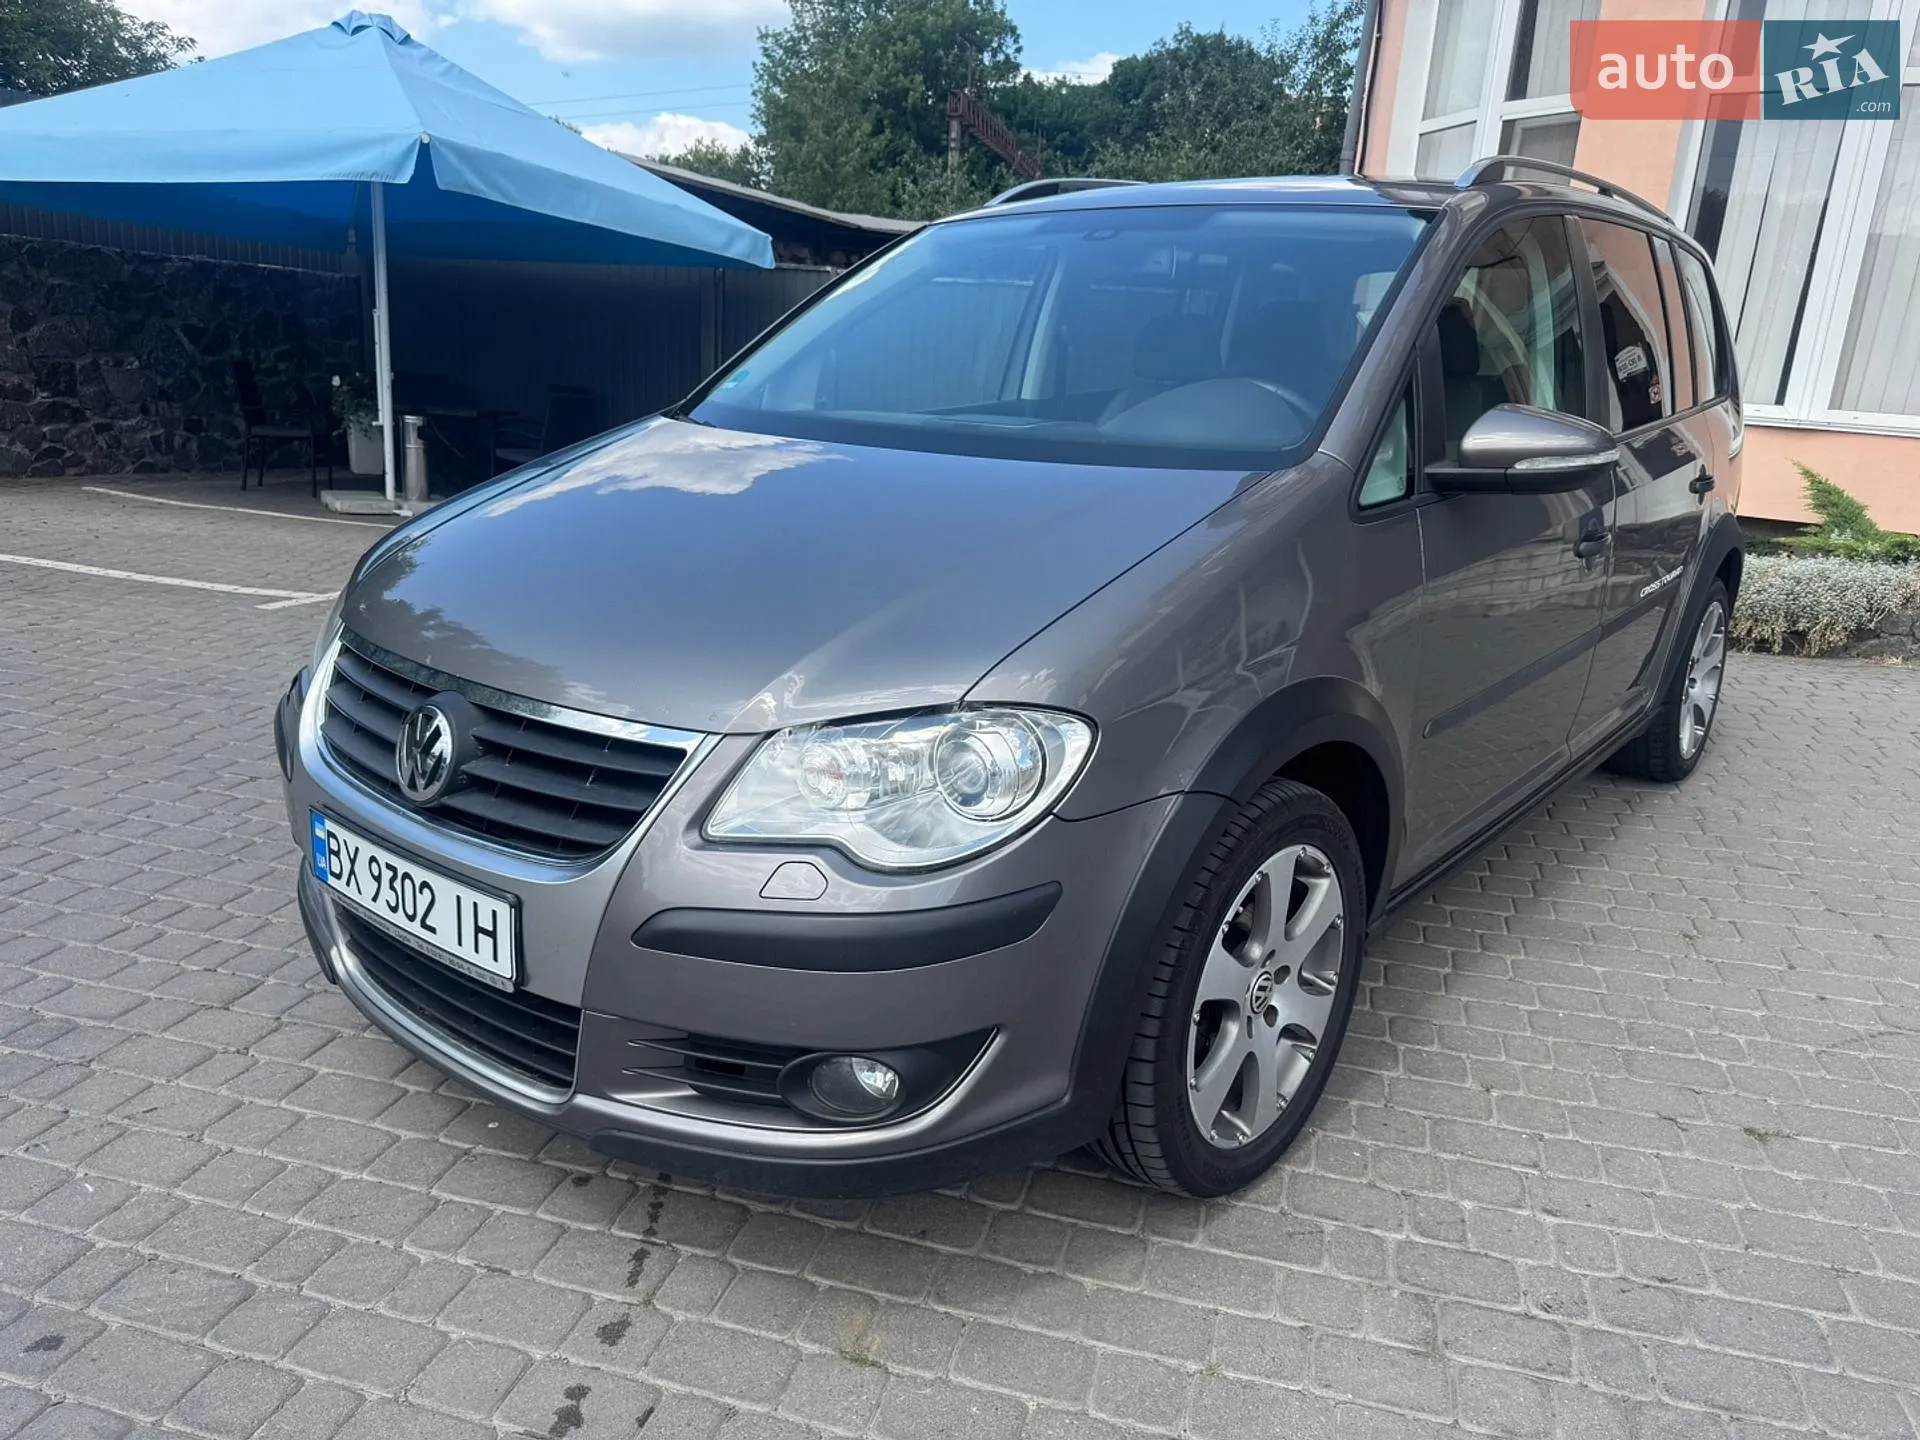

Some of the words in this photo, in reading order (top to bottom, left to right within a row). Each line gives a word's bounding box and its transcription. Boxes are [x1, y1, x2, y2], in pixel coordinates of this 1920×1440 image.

[326, 830, 363, 896] BX
[368, 855, 437, 936] 9302
[455, 894, 499, 963] IH
